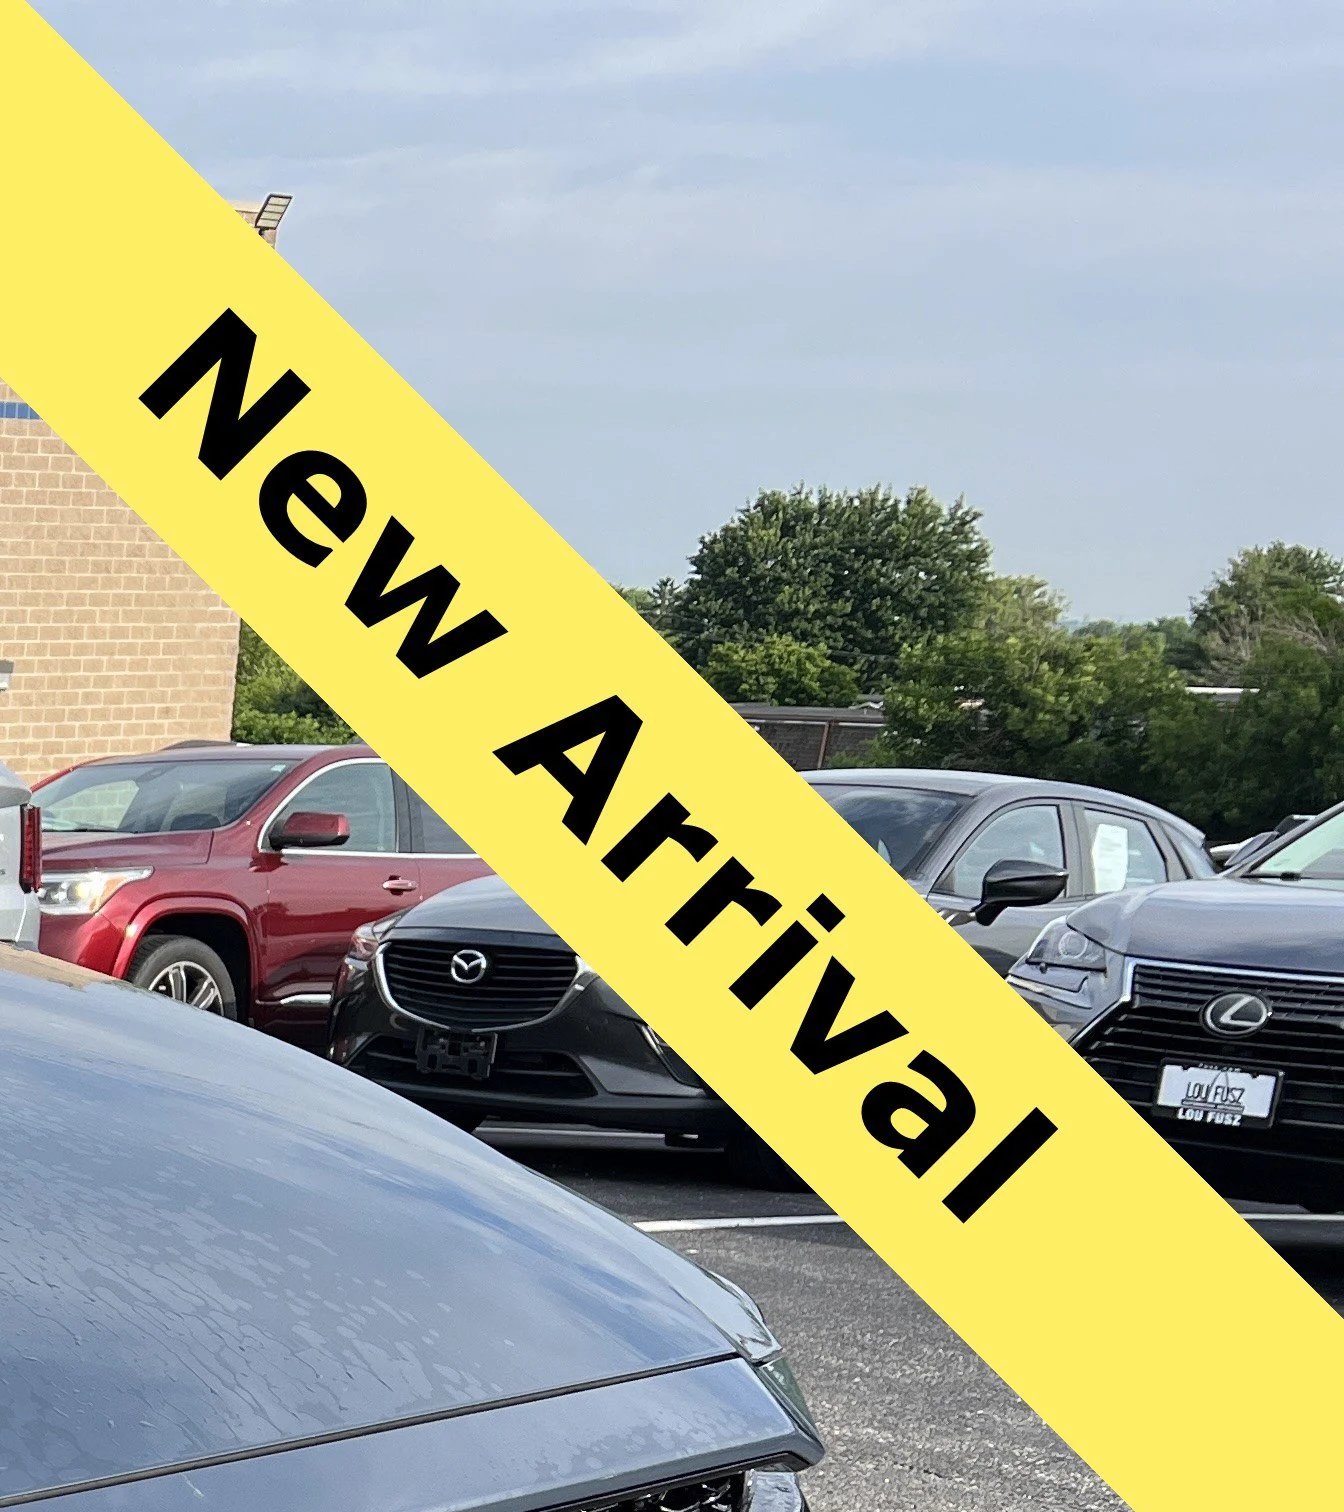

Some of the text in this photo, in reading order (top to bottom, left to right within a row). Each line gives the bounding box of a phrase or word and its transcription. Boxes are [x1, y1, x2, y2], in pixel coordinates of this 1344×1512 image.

[1186, 1081, 1245, 1105] LOU FUSZ
[1177, 1107, 1242, 1126] LOU FUSZ
